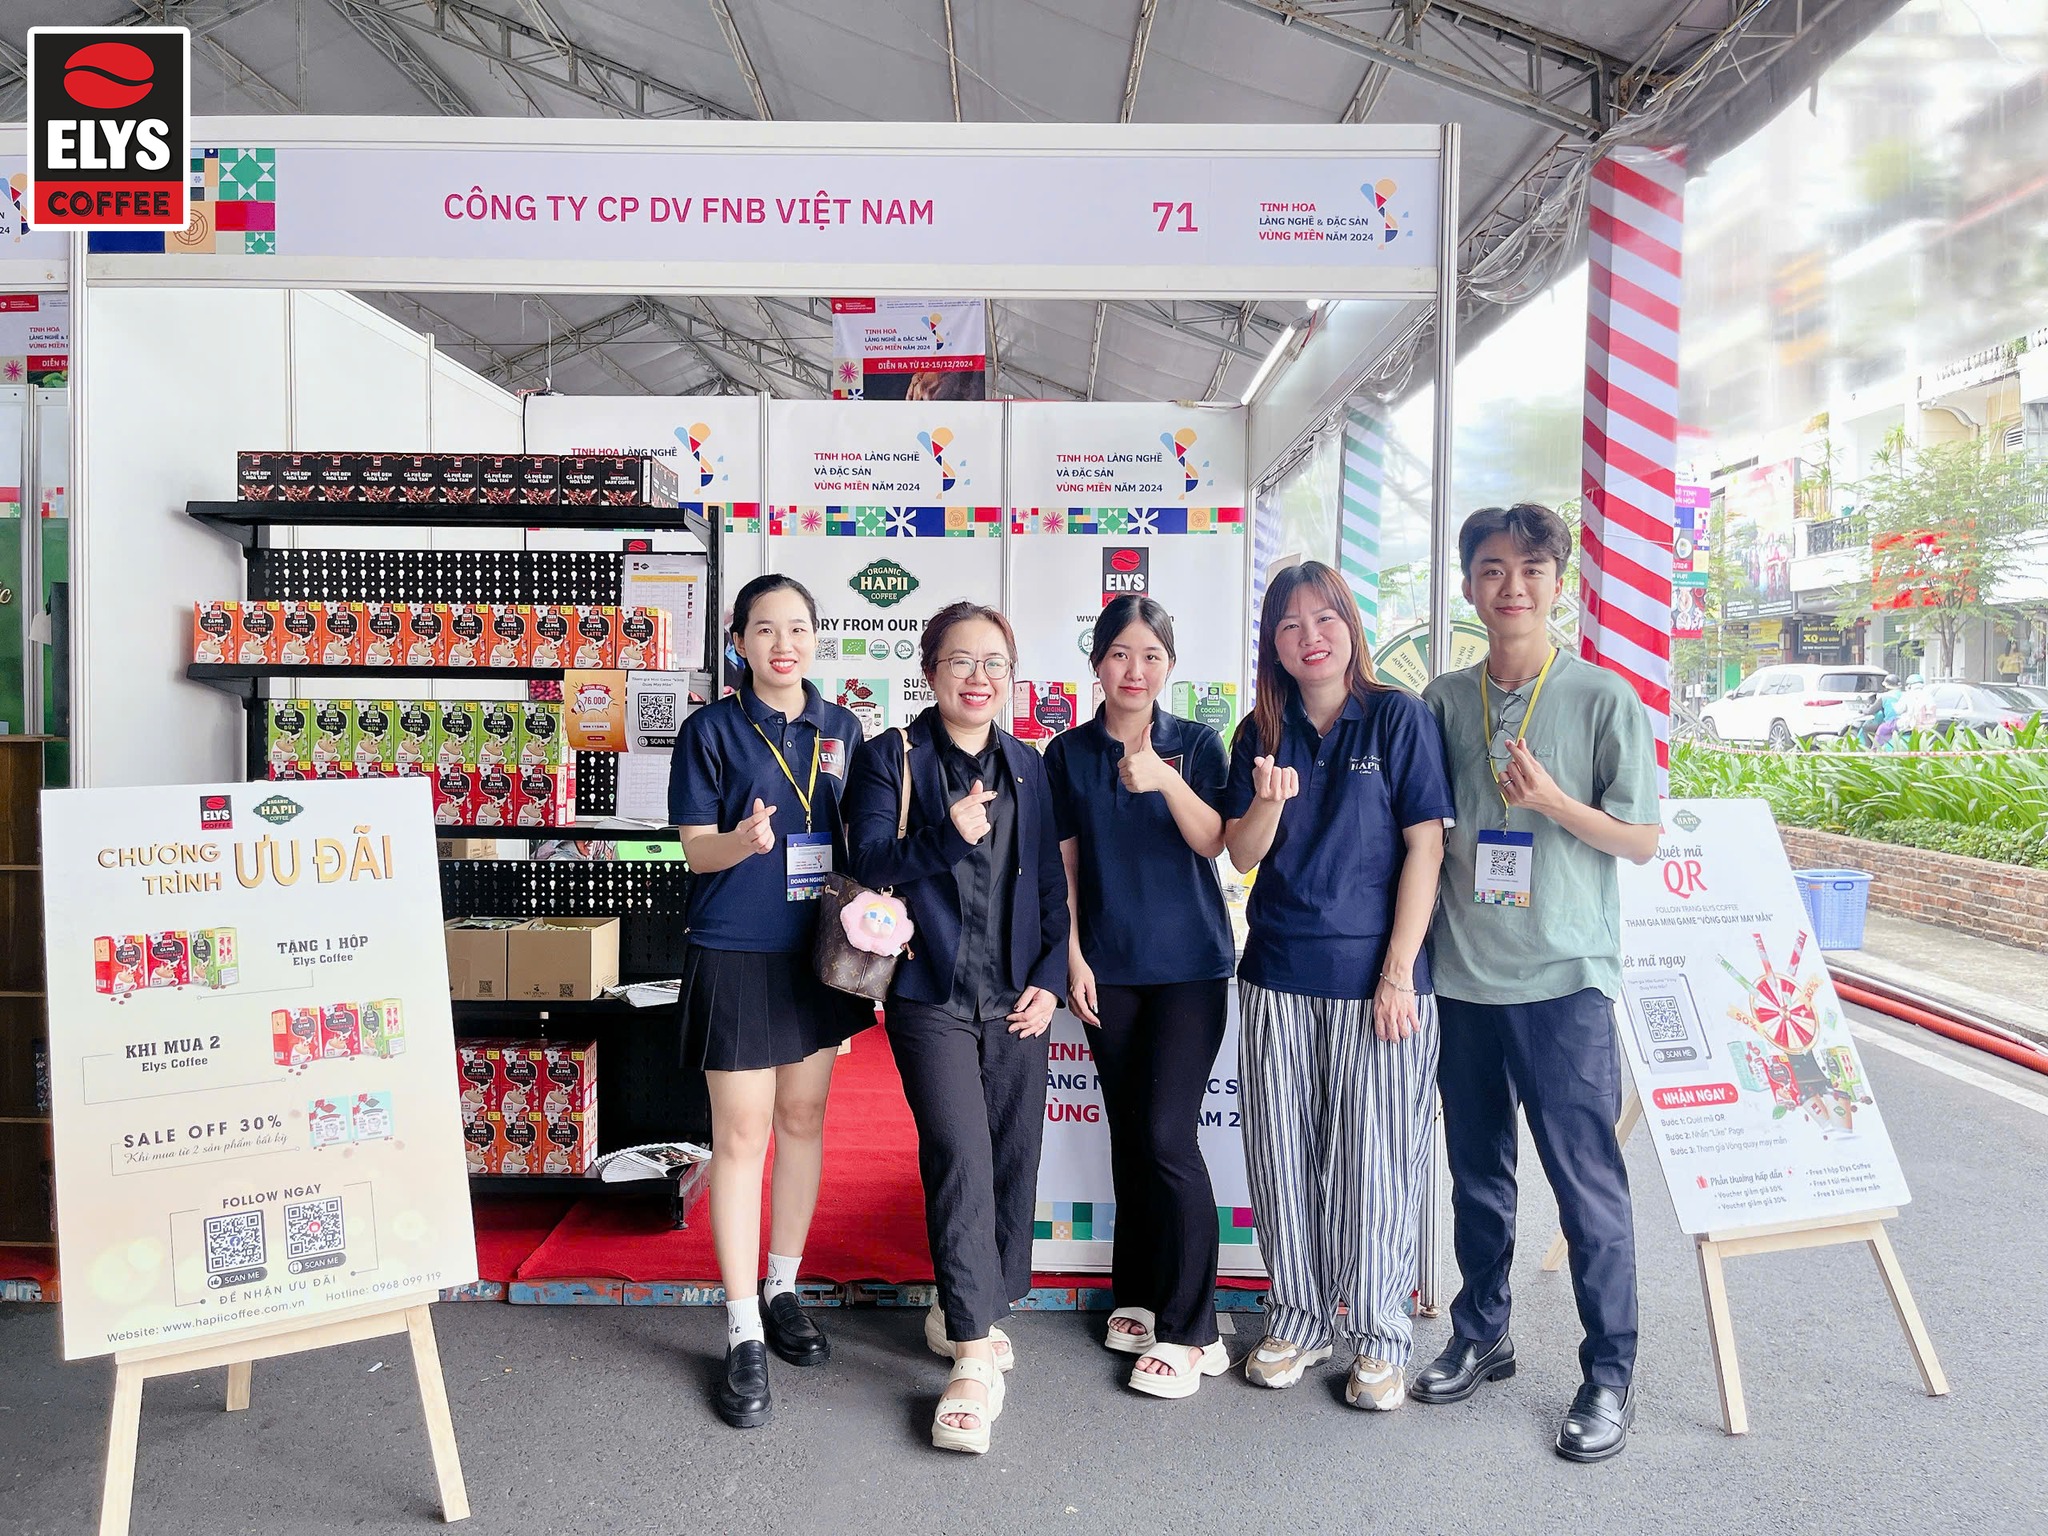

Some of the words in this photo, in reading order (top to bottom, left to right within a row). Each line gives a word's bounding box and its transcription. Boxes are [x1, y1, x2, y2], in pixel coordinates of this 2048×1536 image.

[443, 185, 537, 222] CÔNG
[546, 195, 588, 222] TY
[598, 196, 639, 223] CP
[650, 197, 692, 224] DV
[703, 198, 766, 225] FNB
[775, 190, 851, 231] VIỆT
[861, 199, 933, 226] NAM
[1260, 203, 1289, 212] TINH
[1292, 203, 1316, 212] HOA
[1152, 202, 1199, 233] 71
[1259, 214, 1285, 226] LÀNG
[1287, 214, 1315, 226] NGHỀ
[1316, 218, 1323, 226] &
[1326, 215, 1347, 228] ĐẶC
[1349, 215, 1369, 226] SẢN
[1259, 228, 1291, 241] VÙNG
[1294, 228, 1324, 241] MIỀN
[1325, 230, 1348, 241] NĂM
[1349, 233, 1374, 242] 2024
[878, 360, 896, 369] DIỄN
[571, 447, 595, 456] TINH
[598, 448, 619, 456] HOA
[621, 446, 648, 457] LÀNG
[651, 445, 677, 457] NGHỀ
[814, 452, 839, 461] TINH
[841, 452, 862, 461] HOA
[865, 450, 890, 462] LÀNG
[893, 450, 920, 462] NGHỀ
[1056, 454, 1081, 463] TINH
[1083, 454, 1105, 463] HOA
[1107, 452, 1133, 463] LÀNG
[1135, 451, 1163, 463] NGHỀ
[814, 466, 826, 476] VÀ
[829, 467, 850, 478] ĐẶC
[852, 465, 872, 476] SẢN
[1056, 467, 1069, 477] VÀ
[1072, 468, 1092, 479] ĐẶC
[1094, 467, 1114, 477] SẢN
[814, 480, 841, 491] VÙNG
[843, 479, 869, 491] MIỀN
[872, 480, 895, 491] NĂM
[897, 482, 920, 491] 2024
[1056, 481, 1084, 492] VÙNG
[1085, 481, 1112, 492] MIỀN
[1114, 482, 1137, 492] NĂM
[1139, 484, 1163, 492] 2024
[867, 567, 902, 576] ORGANIC
[860, 576, 908, 591] HAPII
[1105, 574, 1145, 591] ELYS
[870, 592, 898, 600] COFFEE
[843, 619, 884, 631] FROM
[887, 619, 918, 632] OUR
[203, 810, 230, 821] ELYS
[261, 805, 297, 815] HAPII
[97, 842, 221, 869] CHƯƠNG
[234, 834, 300, 889] ƯU
[313, 825, 394, 884] ĐÃI
[1683, 845, 1704, 858] mã
[142, 870, 222, 895] TRÌNH
[1663, 860, 1708, 899] QR
[1625, 919, 1647, 927] THAM
[1647, 919, 1660, 927] GIA
[1660, 918, 1677, 926] MINI
[1677, 917, 1697, 925] GAME
[1721, 915, 1740, 924] QUAY
[1740, 915, 1755, 923] MAY
[277, 940, 322, 956] TẶNG
[325, 938, 332, 951] 1
[338, 935, 369, 952] HỘP
[293, 954, 317, 967] Elys
[319, 952, 353, 964] Coffee
[1637, 954, 1657, 967] mã
[1658, 955, 1686, 969] ngay
[125, 1043, 160, 1060] KHI
[164, 1038, 203, 1056] MUA
[209, 1036, 221, 1051] 2
[1049, 1043, 1094, 1061] INH
[1665, 1050, 1681, 1060] SCAN
[1681, 1048, 1692, 1058] ME
[141, 1060, 167, 1073] Elys
[170, 1056, 208, 1070] Coffee
[1046, 1070, 1087, 1090] ÀNG
[1662, 1089, 1697, 1107] NHẬN
[1697, 1088, 1726, 1103] NGAY
[1045, 1097, 1100, 1123] ÙNG
[123, 1128, 177, 1149] SALE
[188, 1121, 229, 1139] OFF
[240, 1114, 282, 1133] 30%
[124, 1151, 150, 1165] Khi
[151, 1149, 176, 1161] mua
[190, 1145, 200, 1156] 2
[202, 1141, 222, 1154] sản
[223, 1136, 253, 1153] phẩm
[222, 1190, 279, 1209] FOLLOW
[284, 1183, 323, 1199] NGAY
[304, 1258, 325, 1270] SCAN
[326, 1256, 339, 1267] ME
[224, 1272, 245, 1285] SCAN
[246, 1270, 261, 1281] ME
[218, 1287, 237, 1305] ĐỂ
[243, 1283, 283, 1302] NHẬN
[288, 1279, 308, 1292] ƯU
[313, 1274, 337, 1289] ĐÃI
[325, 1286, 369, 1302] Hotline:
[372, 1278, 400, 1293] 0968
[402, 1275, 424, 1289] 099
[426, 1271, 442, 1284] 119
[107, 1325, 160, 1343] Website:
[162, 1299, 305, 1333] www.hapiicoffee.com.vn
